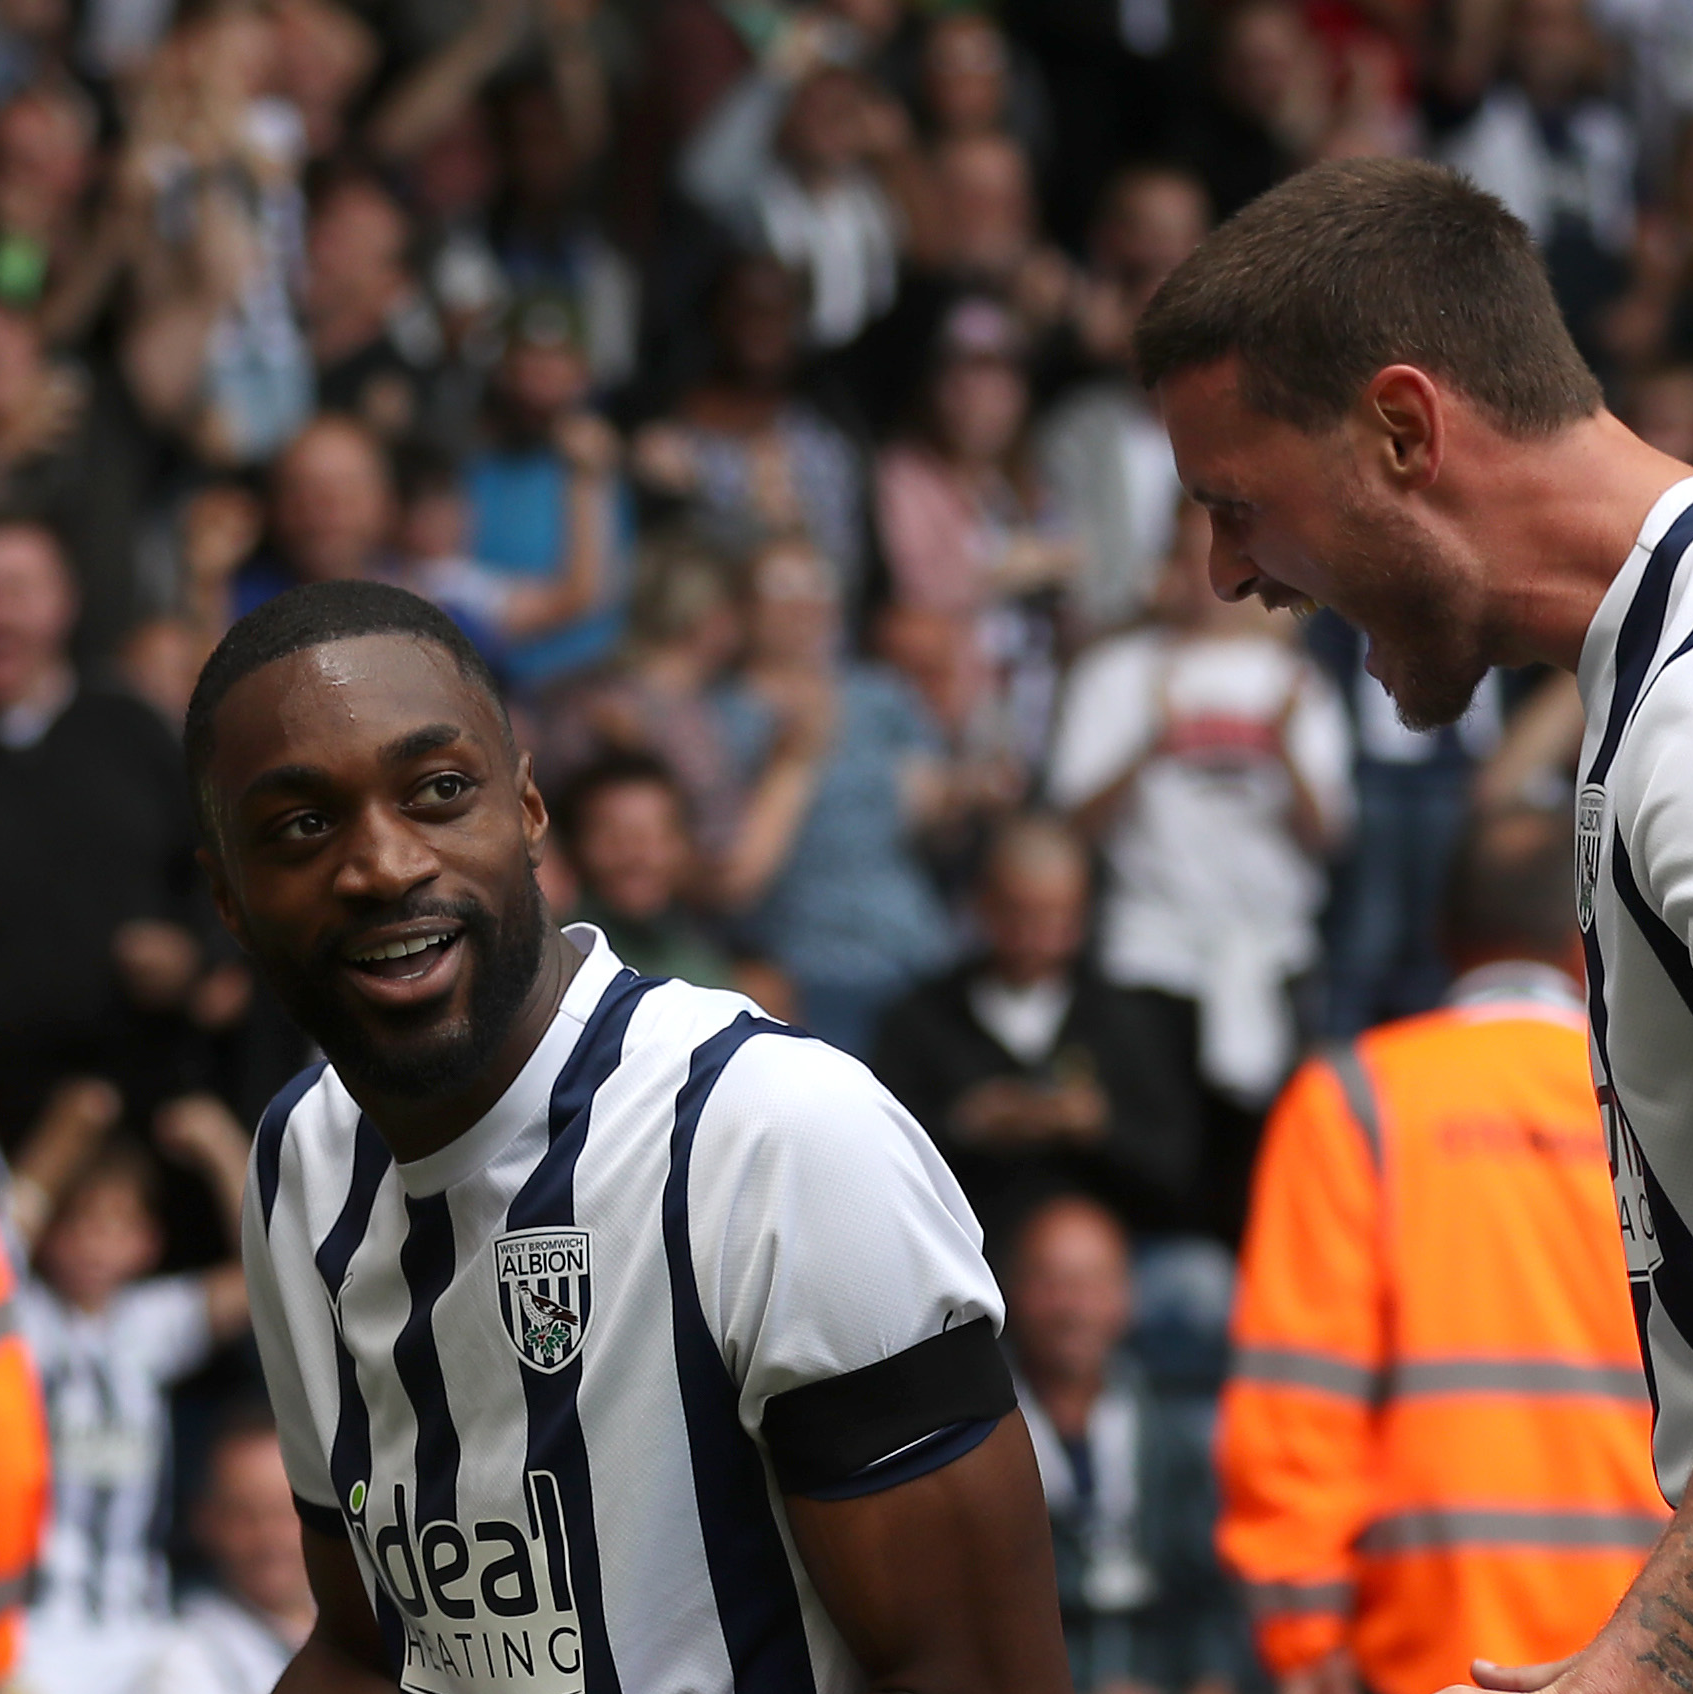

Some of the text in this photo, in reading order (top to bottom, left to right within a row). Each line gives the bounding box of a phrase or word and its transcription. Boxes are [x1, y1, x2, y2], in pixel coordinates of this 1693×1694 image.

[499, 1238, 583, 1254] WEST BROMWICH
[501, 1249, 584, 1277] ALBION
[351, 1472, 574, 1621] ideal
